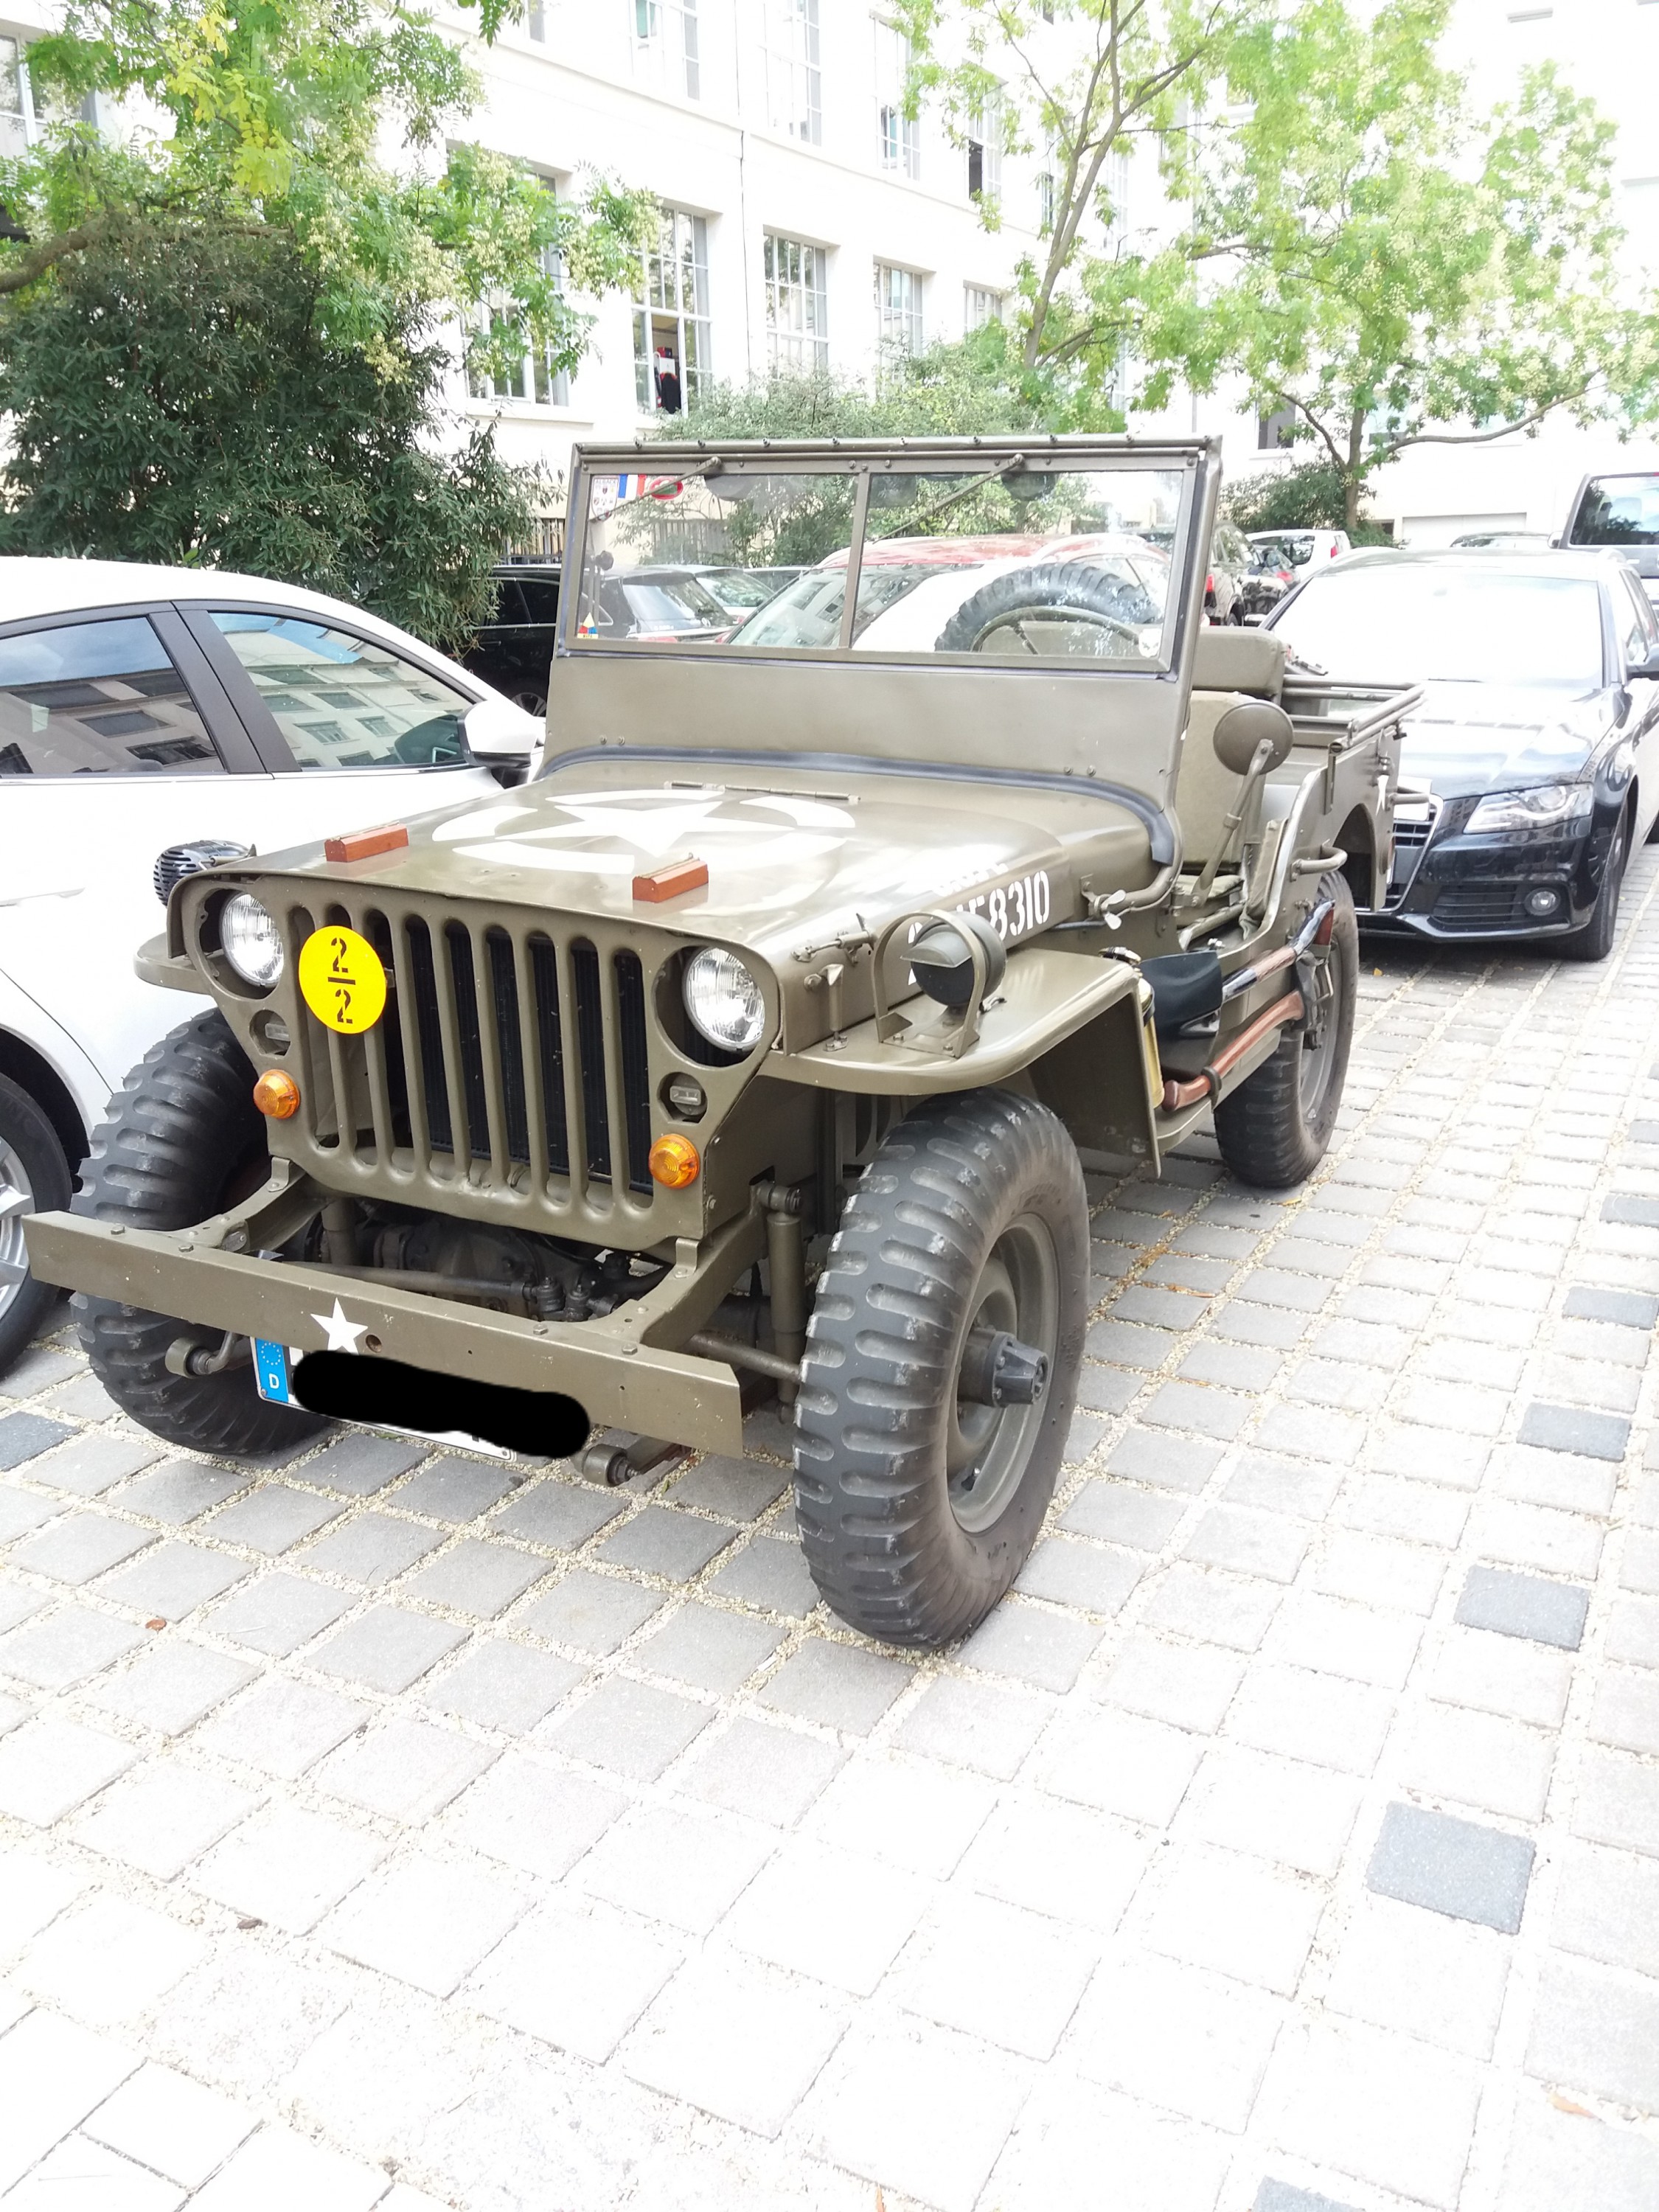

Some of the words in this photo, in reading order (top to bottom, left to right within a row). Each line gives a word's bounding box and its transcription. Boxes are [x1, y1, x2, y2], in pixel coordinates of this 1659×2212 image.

[331, 937, 349, 973] 2
[335, 989, 353, 1024] 2
[268, 1373, 279, 1389] D
